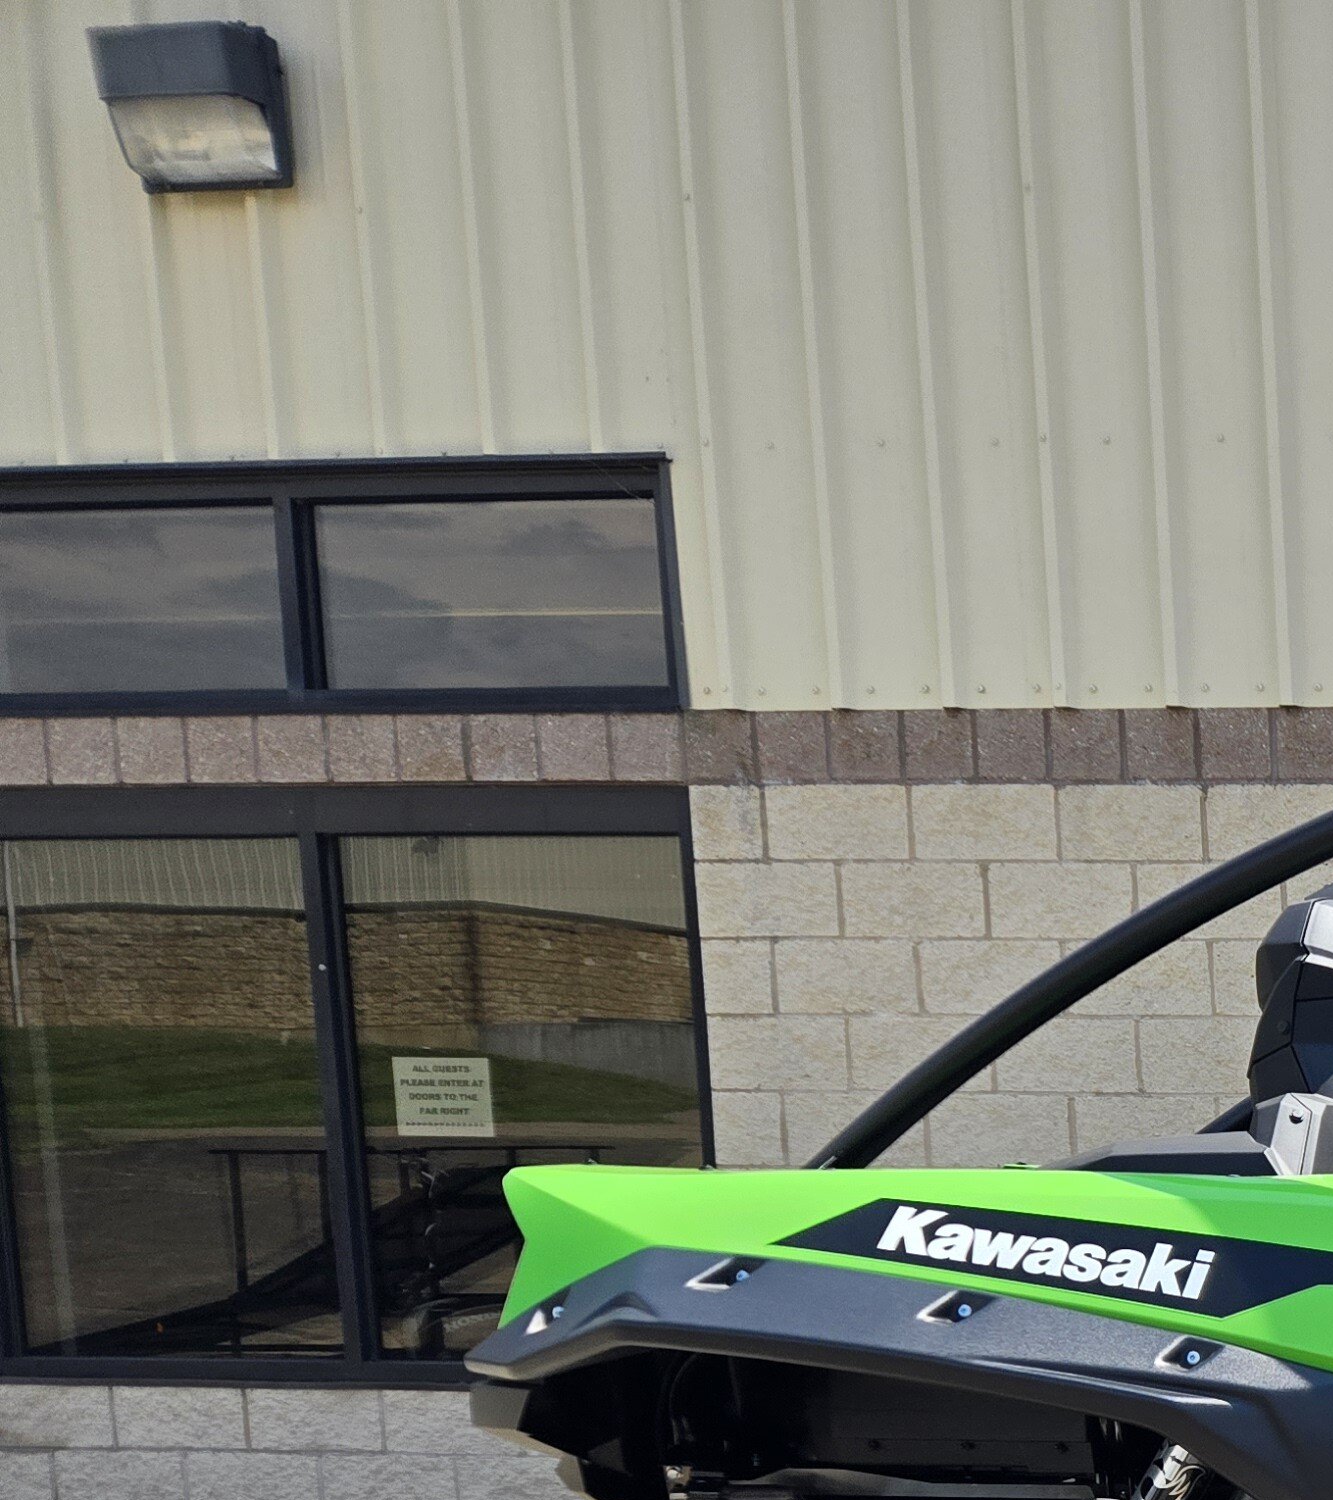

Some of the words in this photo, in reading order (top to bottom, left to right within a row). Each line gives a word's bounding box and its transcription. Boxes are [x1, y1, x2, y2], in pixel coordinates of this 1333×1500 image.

[412, 1065, 431, 1073] ALL
[400, 1079, 435, 1087] PLEASE
[470, 1080, 485, 1088] AT
[409, 1093, 441, 1101] DOORS
[443, 1093, 457, 1101] TO
[458, 1093, 479, 1102] THE
[876, 1205, 1216, 1300] Kawasaki
